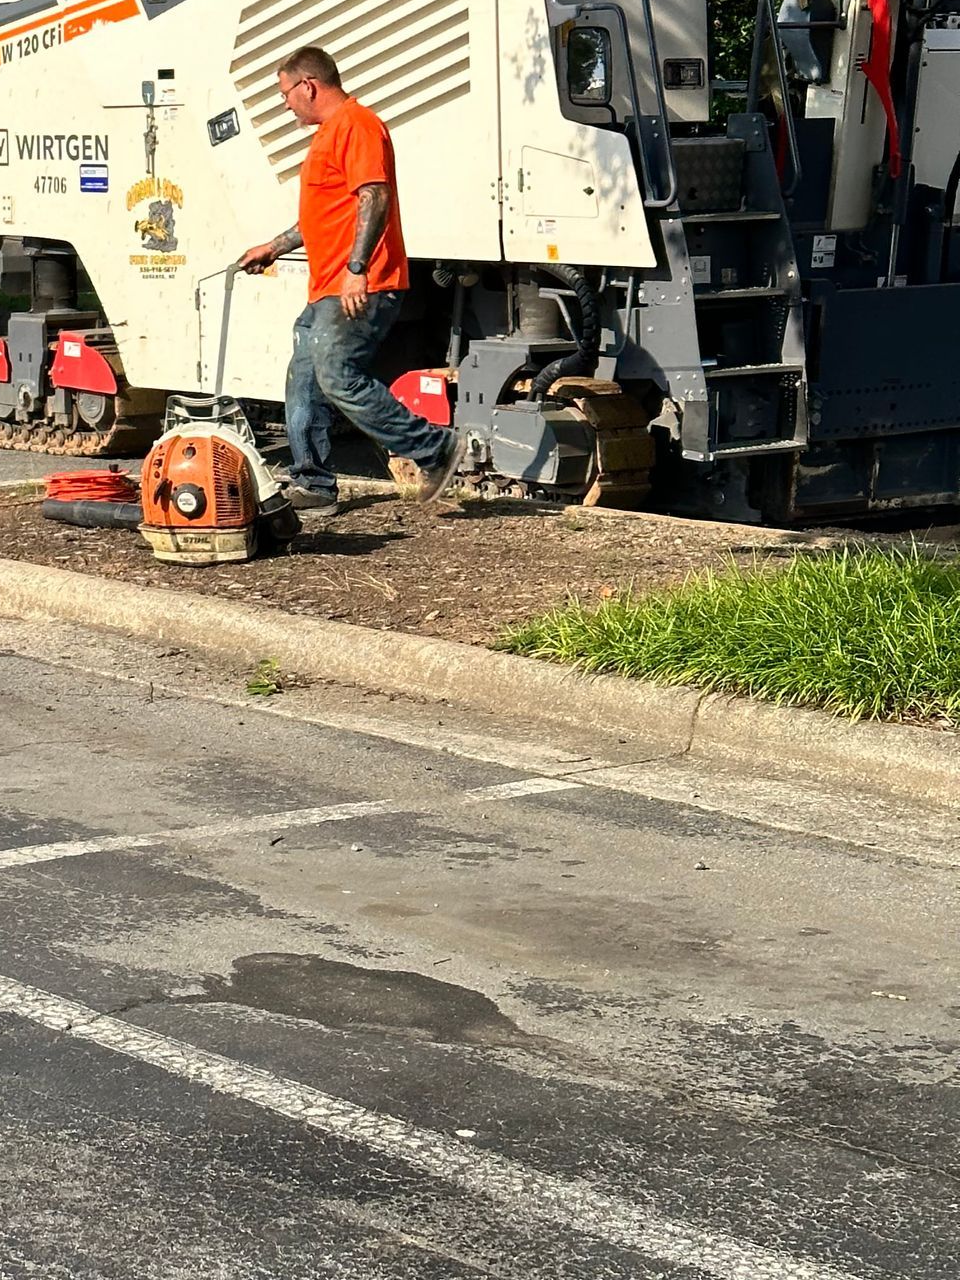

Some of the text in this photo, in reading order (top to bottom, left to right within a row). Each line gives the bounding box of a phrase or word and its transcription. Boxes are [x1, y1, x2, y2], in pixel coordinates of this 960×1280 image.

[1, 42, 14, 65] W
[16, 33, 39, 59] 120
[15, 134, 109, 161] WIRTGEN
[33, 176, 68, 194] 47706
[182, 536, 212, 544] STIHL
